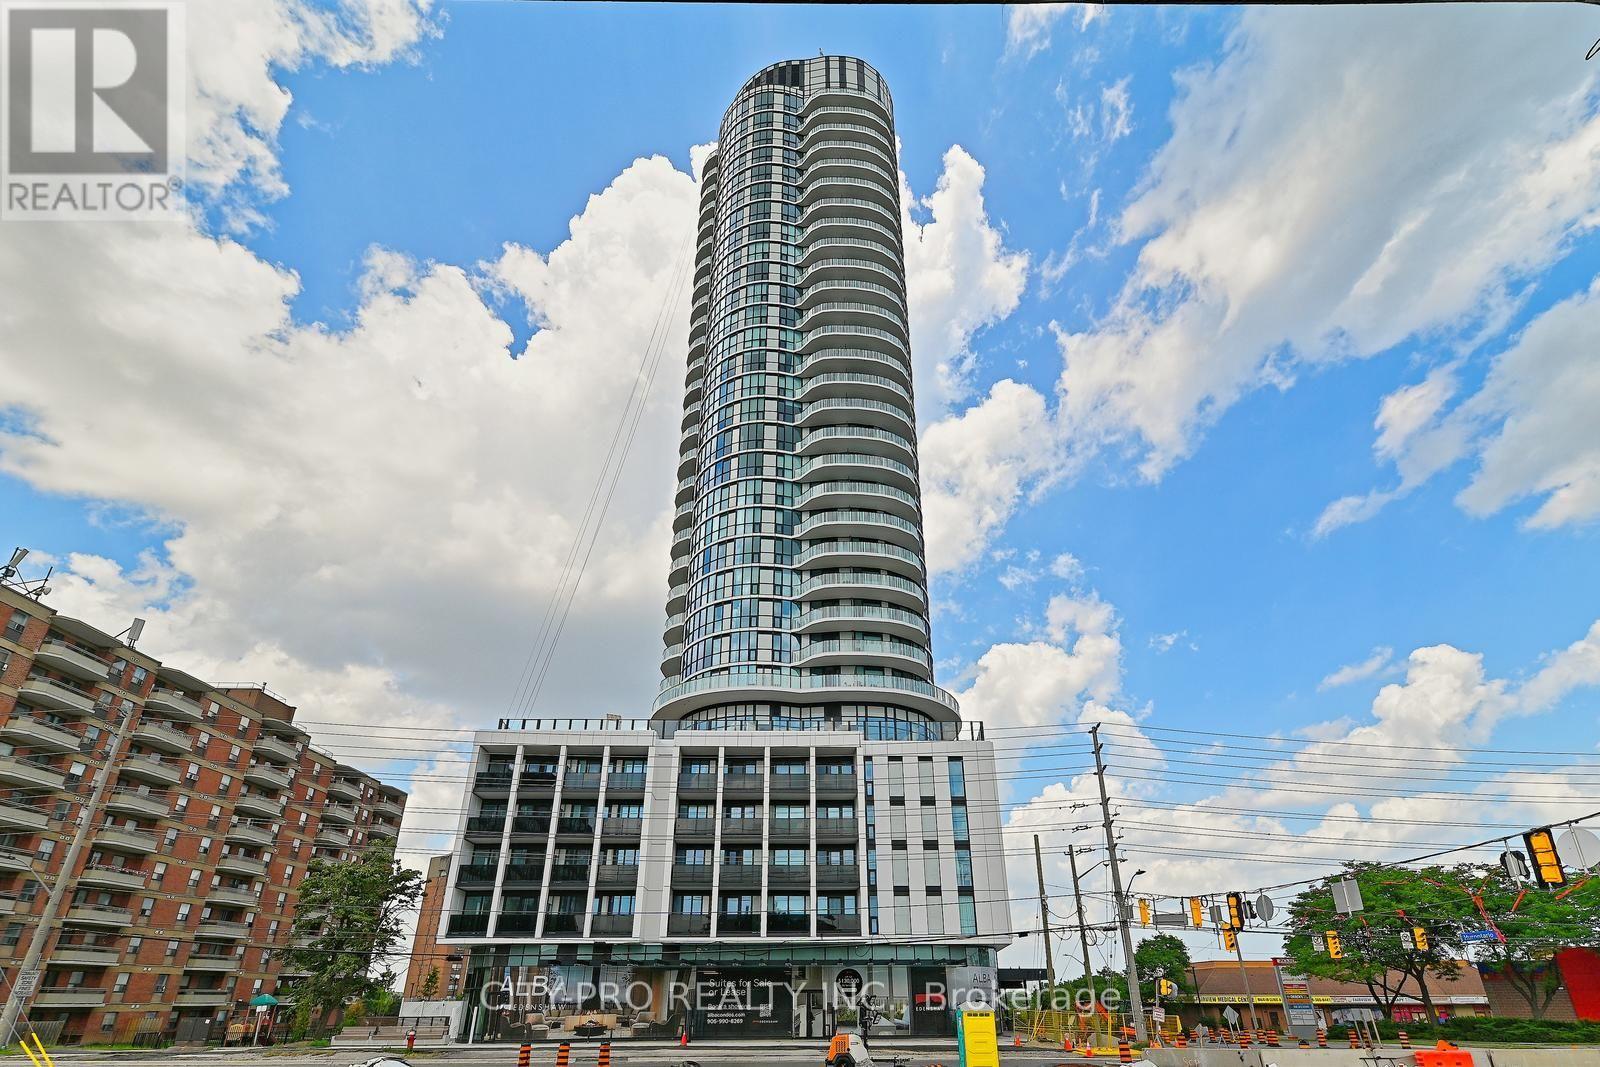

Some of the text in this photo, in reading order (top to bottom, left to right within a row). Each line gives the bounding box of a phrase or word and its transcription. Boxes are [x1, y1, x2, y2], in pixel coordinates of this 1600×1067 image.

[708, 978, 772, 988] Suites for Sale
[720, 988, 746, 996] Lease
